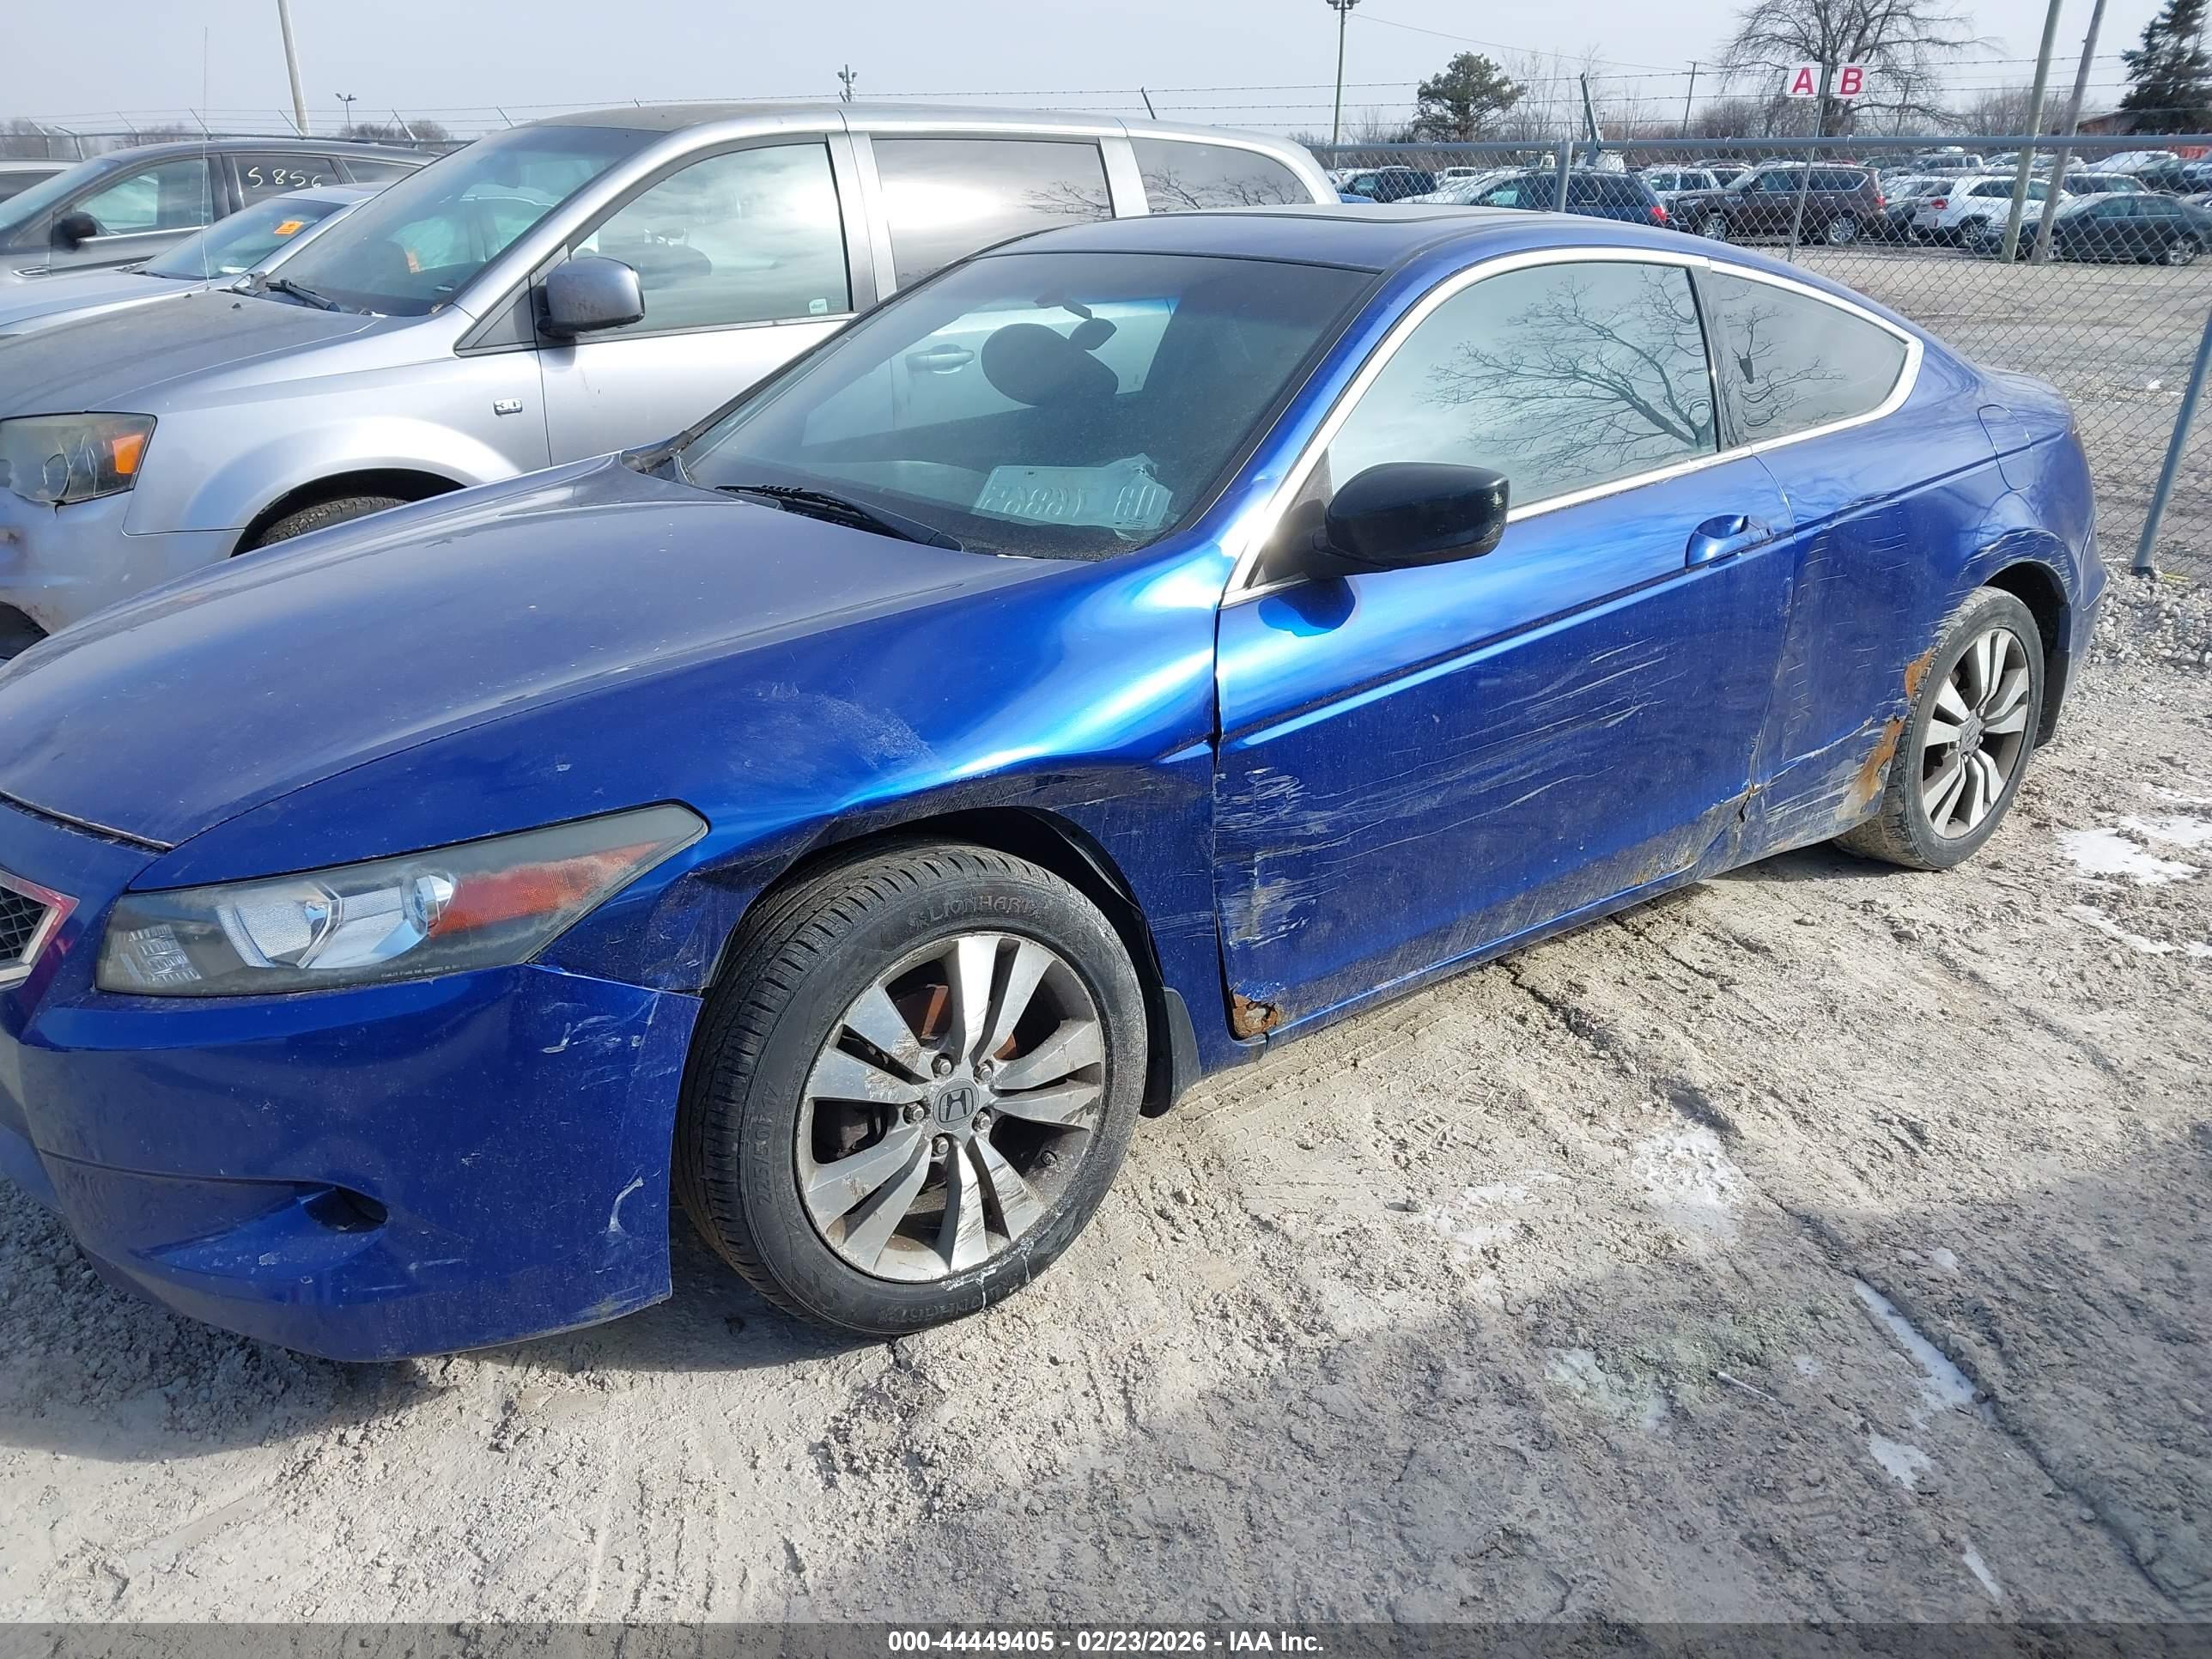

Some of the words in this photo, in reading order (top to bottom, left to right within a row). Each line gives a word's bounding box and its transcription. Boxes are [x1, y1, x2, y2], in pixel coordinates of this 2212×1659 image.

[1792, 67, 1814, 94] A
[1840, 68, 1863, 94] B
[247, 167, 323, 188] 5856
